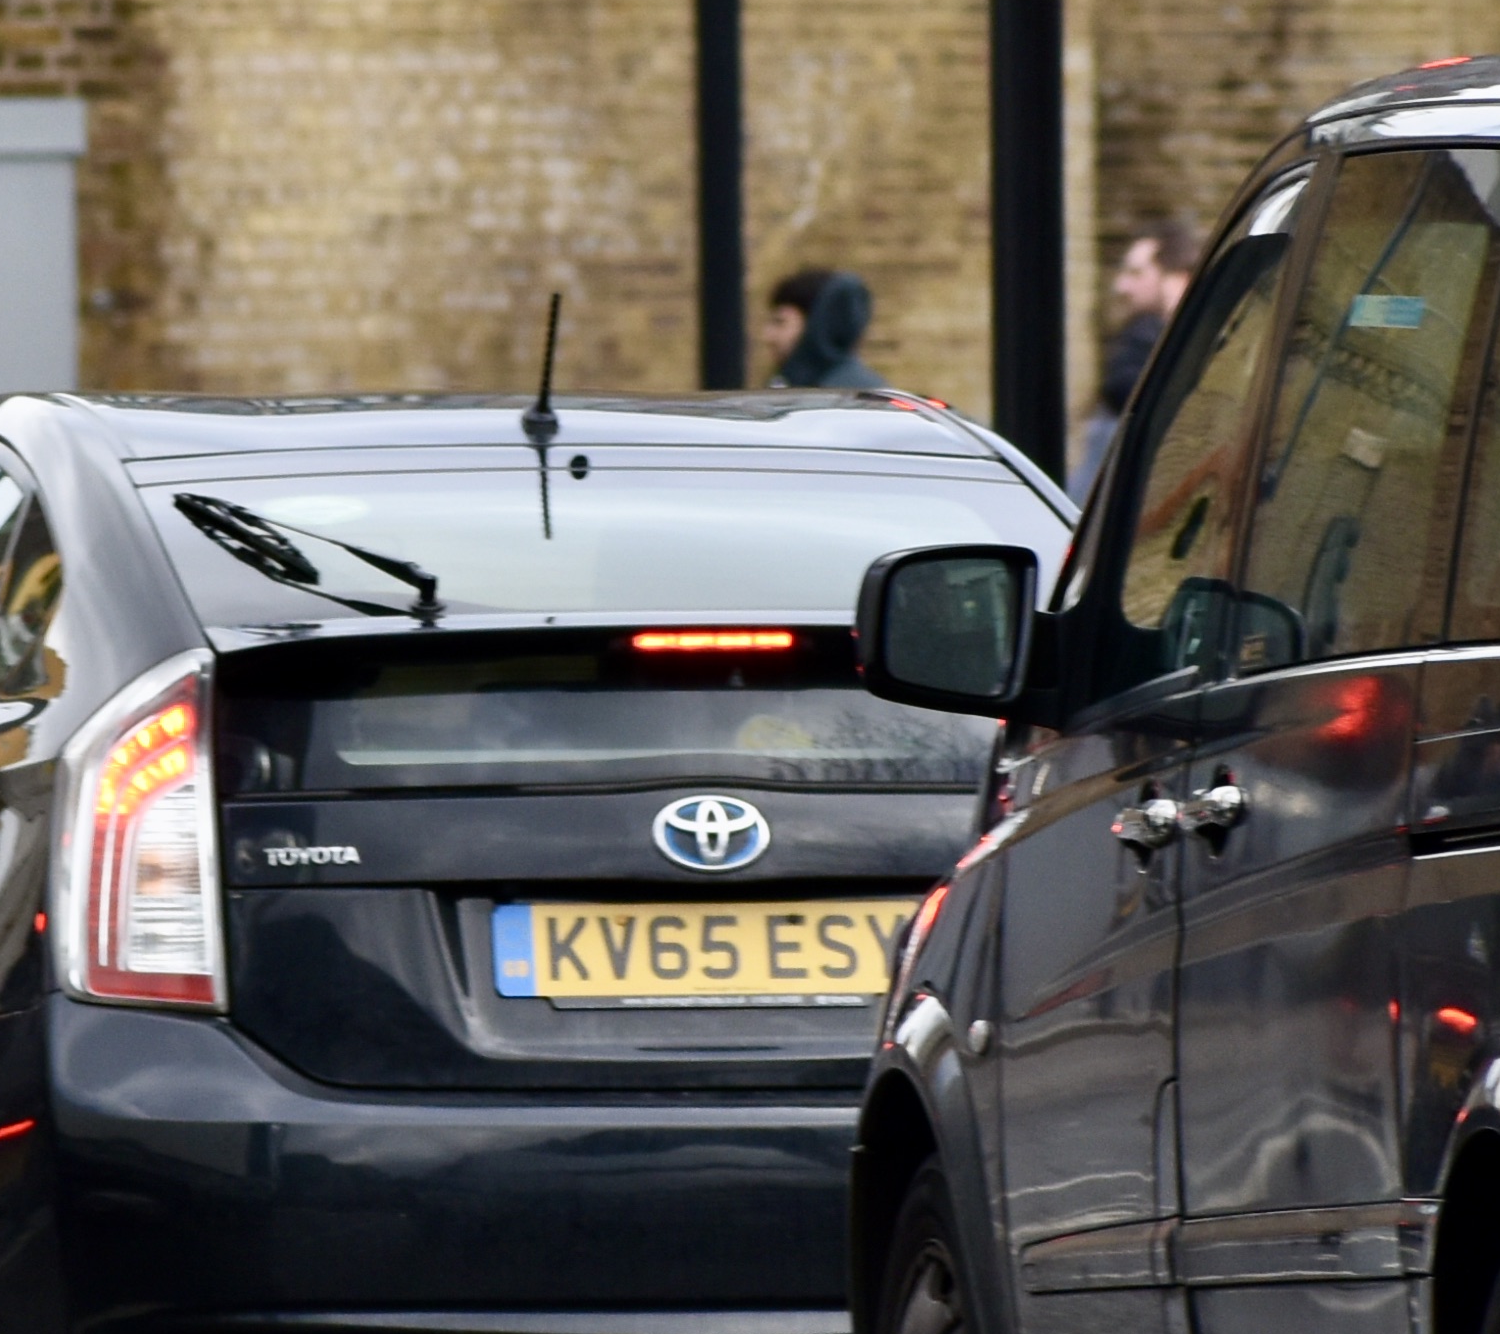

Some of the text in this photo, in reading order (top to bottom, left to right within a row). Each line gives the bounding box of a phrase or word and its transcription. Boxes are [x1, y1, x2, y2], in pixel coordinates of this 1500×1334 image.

[262, 846, 361, 866] TOYOTA
[545, 914, 905, 981] KV65 ESY
